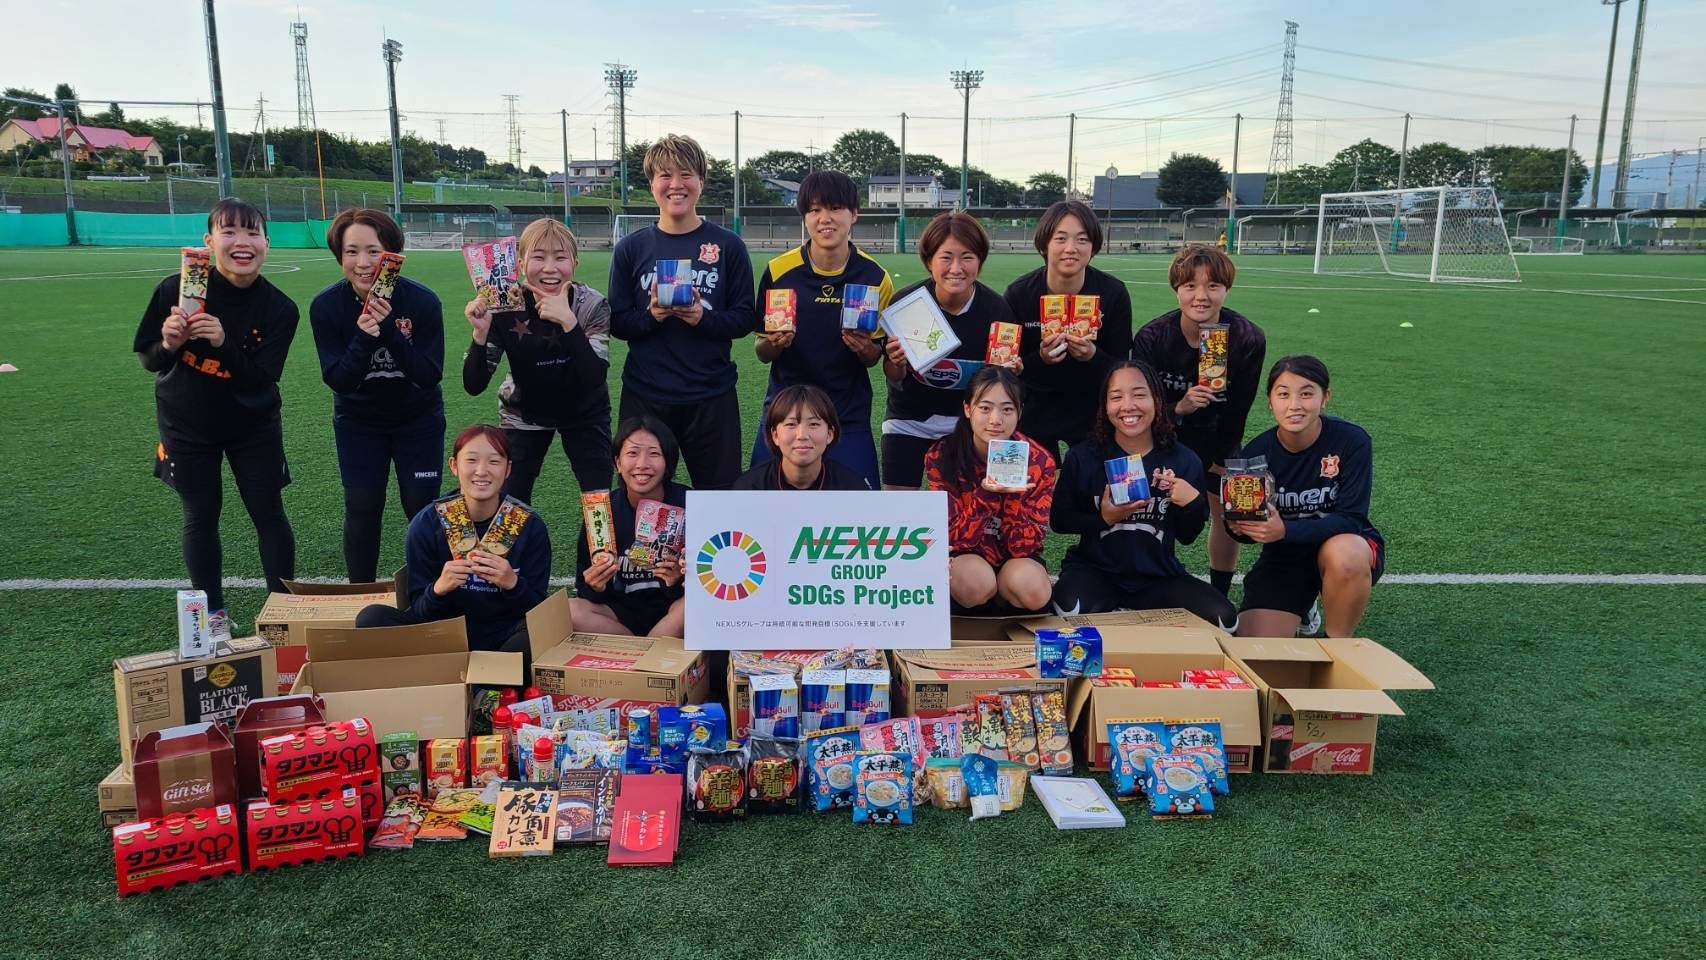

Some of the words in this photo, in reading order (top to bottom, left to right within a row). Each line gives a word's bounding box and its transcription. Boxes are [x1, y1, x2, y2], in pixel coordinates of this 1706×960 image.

[592, 510, 605, 548] 沖縄そば
[788, 526, 936, 564] NEXUS
[832, 565, 886, 580] GROUP
[788, 585, 845, 606] SDGs
[854, 584, 934, 609] Project
[200, 685, 248, 700] PLATINUM
[200, 692, 250, 714] BLACK
[760, 707, 776, 716] Red
[778, 706, 792, 714] Bull
[852, 700, 867, 708] Red
[868, 700, 882, 708] Bull
[1122, 734, 1154, 743] 太平燕
[1177, 734, 1214, 746] 太平燕
[820, 743, 853, 758] 太平燕
[276, 750, 337, 774] タフマン
[865, 760, 900, 772] 太平燕
[164, 786, 189, 800] Gift
[190, 782, 212, 795] Set
[256, 820, 321, 842] タフマン
[507, 815, 520, 848] カレー
[126, 840, 195, 866] タフマン
